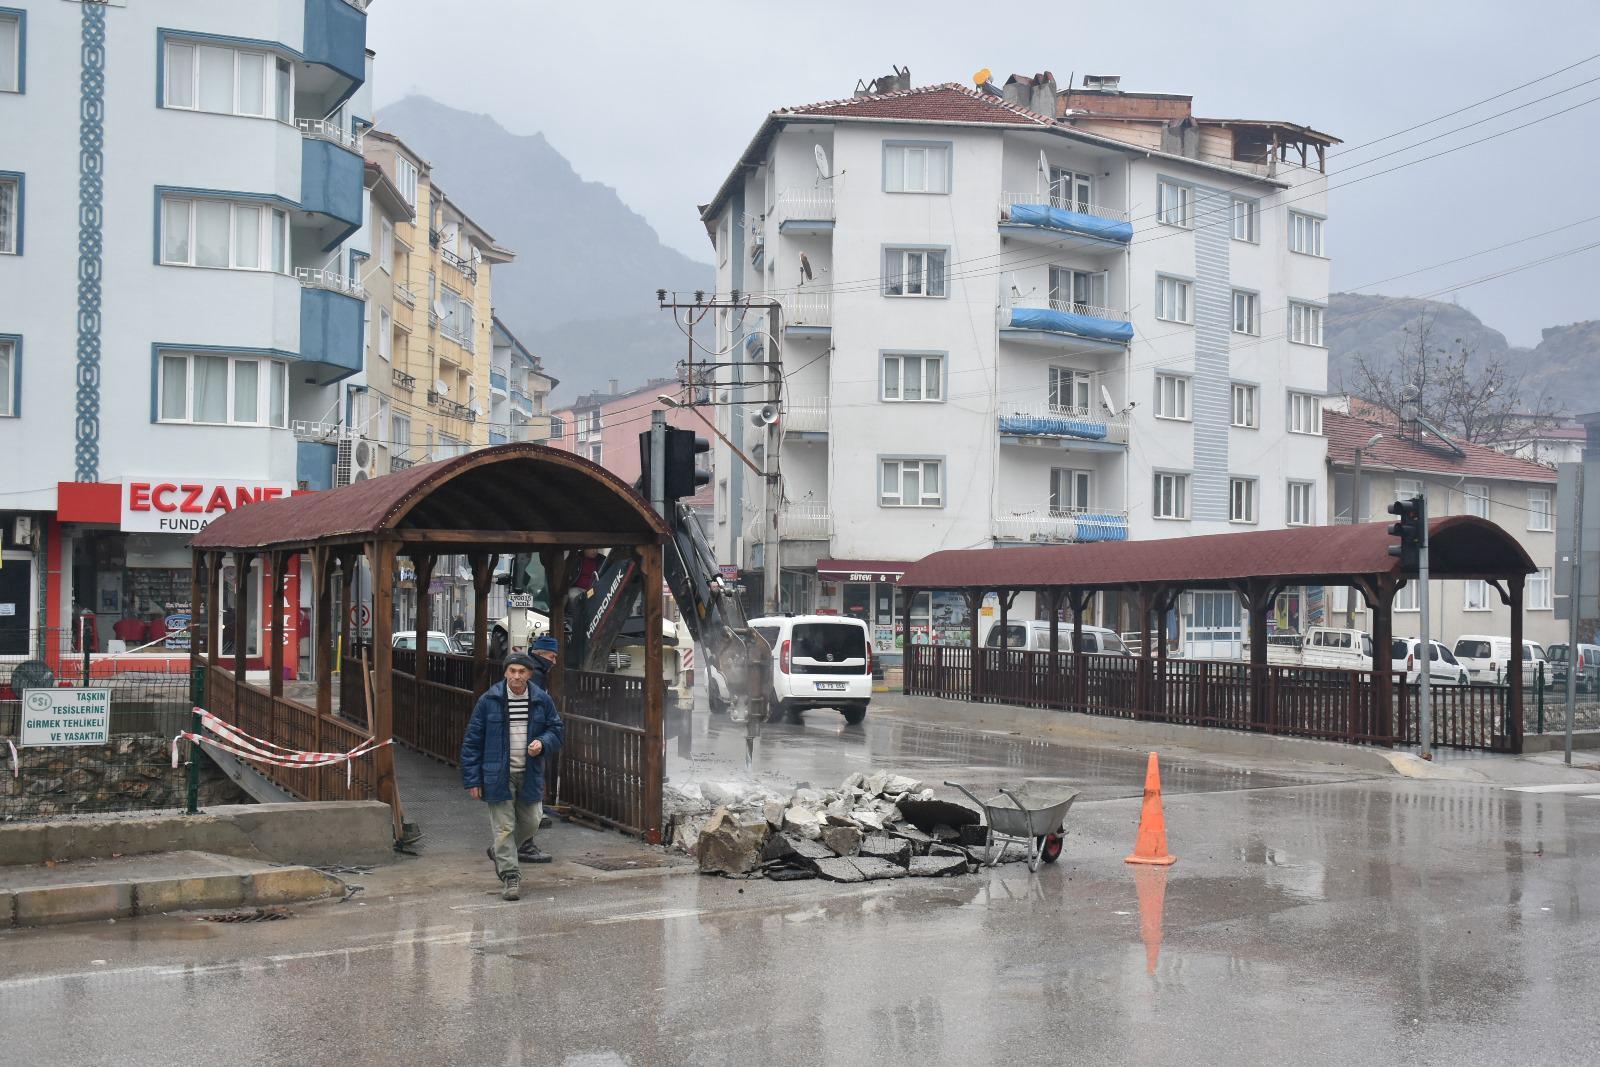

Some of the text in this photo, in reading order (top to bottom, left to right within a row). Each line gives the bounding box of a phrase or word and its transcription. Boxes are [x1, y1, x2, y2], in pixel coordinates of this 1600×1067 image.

[77, 692, 106, 703] TAŞKIN
[52, 704, 105, 715] TESİSLERİNE
[26, 718, 105, 729] GİRMEK TEHLİKELİ
[50, 731, 104, 741] VE YASAKTIR
